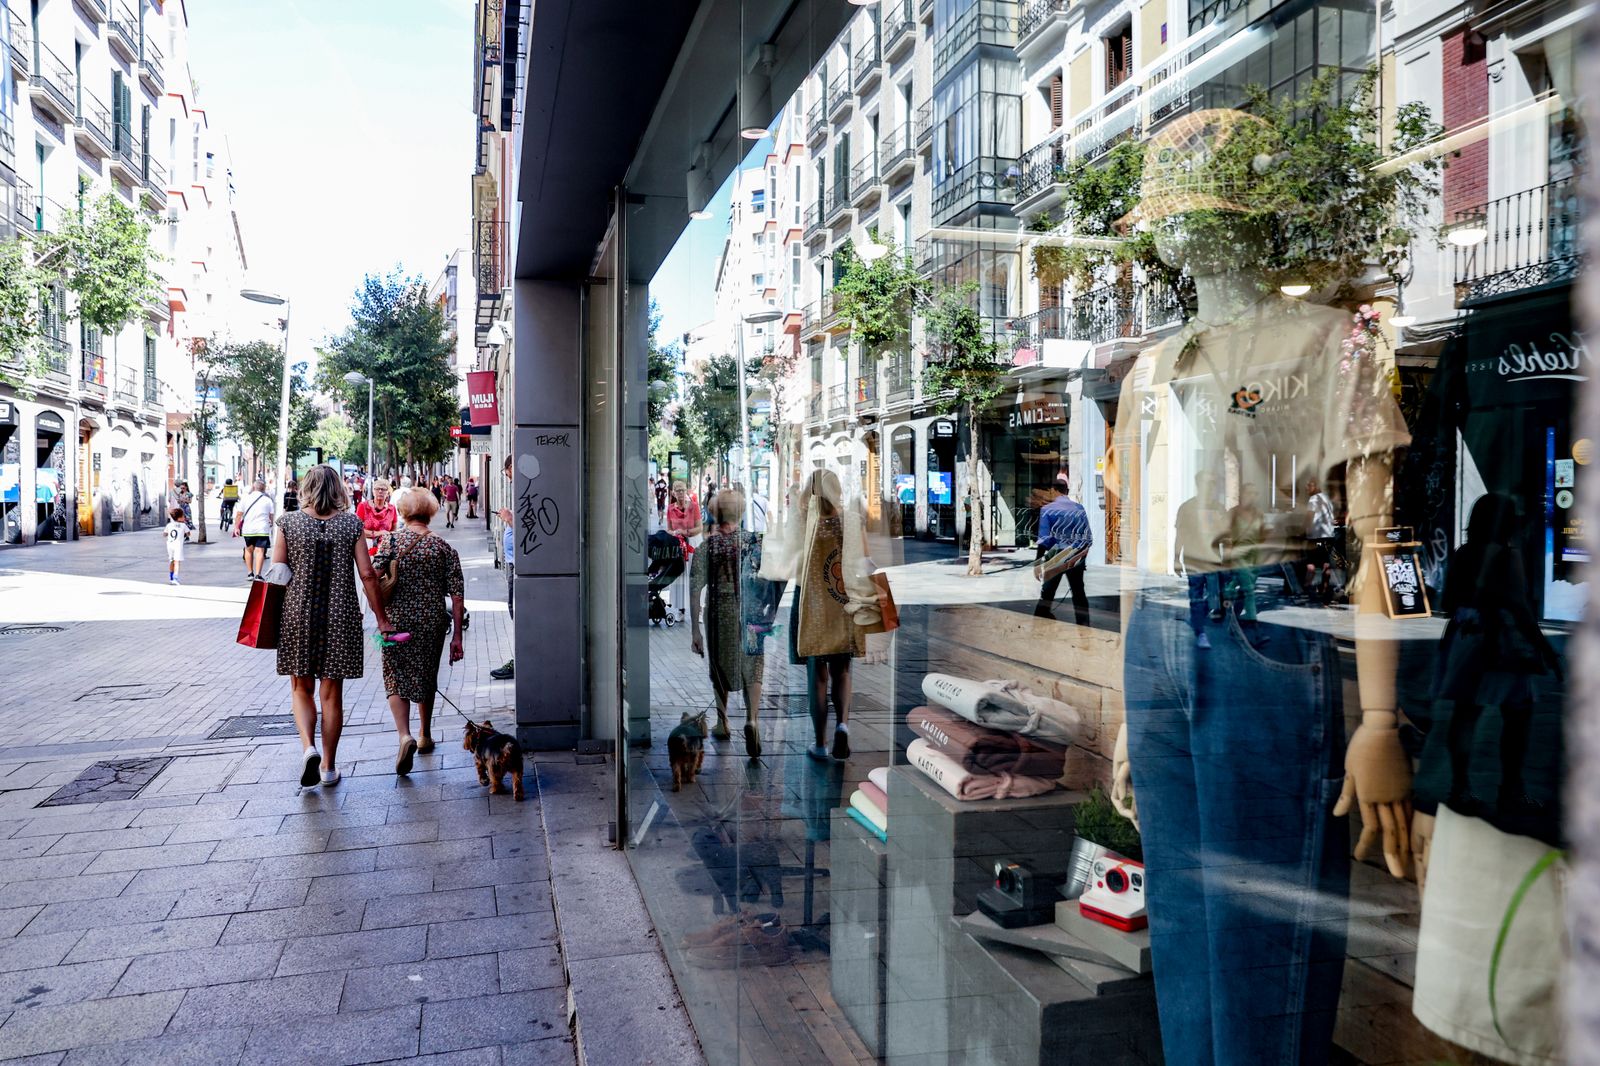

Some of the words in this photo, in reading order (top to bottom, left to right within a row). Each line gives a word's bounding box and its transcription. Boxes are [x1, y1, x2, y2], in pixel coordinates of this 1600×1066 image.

[471, 393, 494, 404] MUJI
[170, 529, 178, 541] 9
[935, 679, 962, 697] KAOTIKO
[920, 719, 949, 745] KAOTIKO
[917, 756, 944, 781] KAOTIKO
